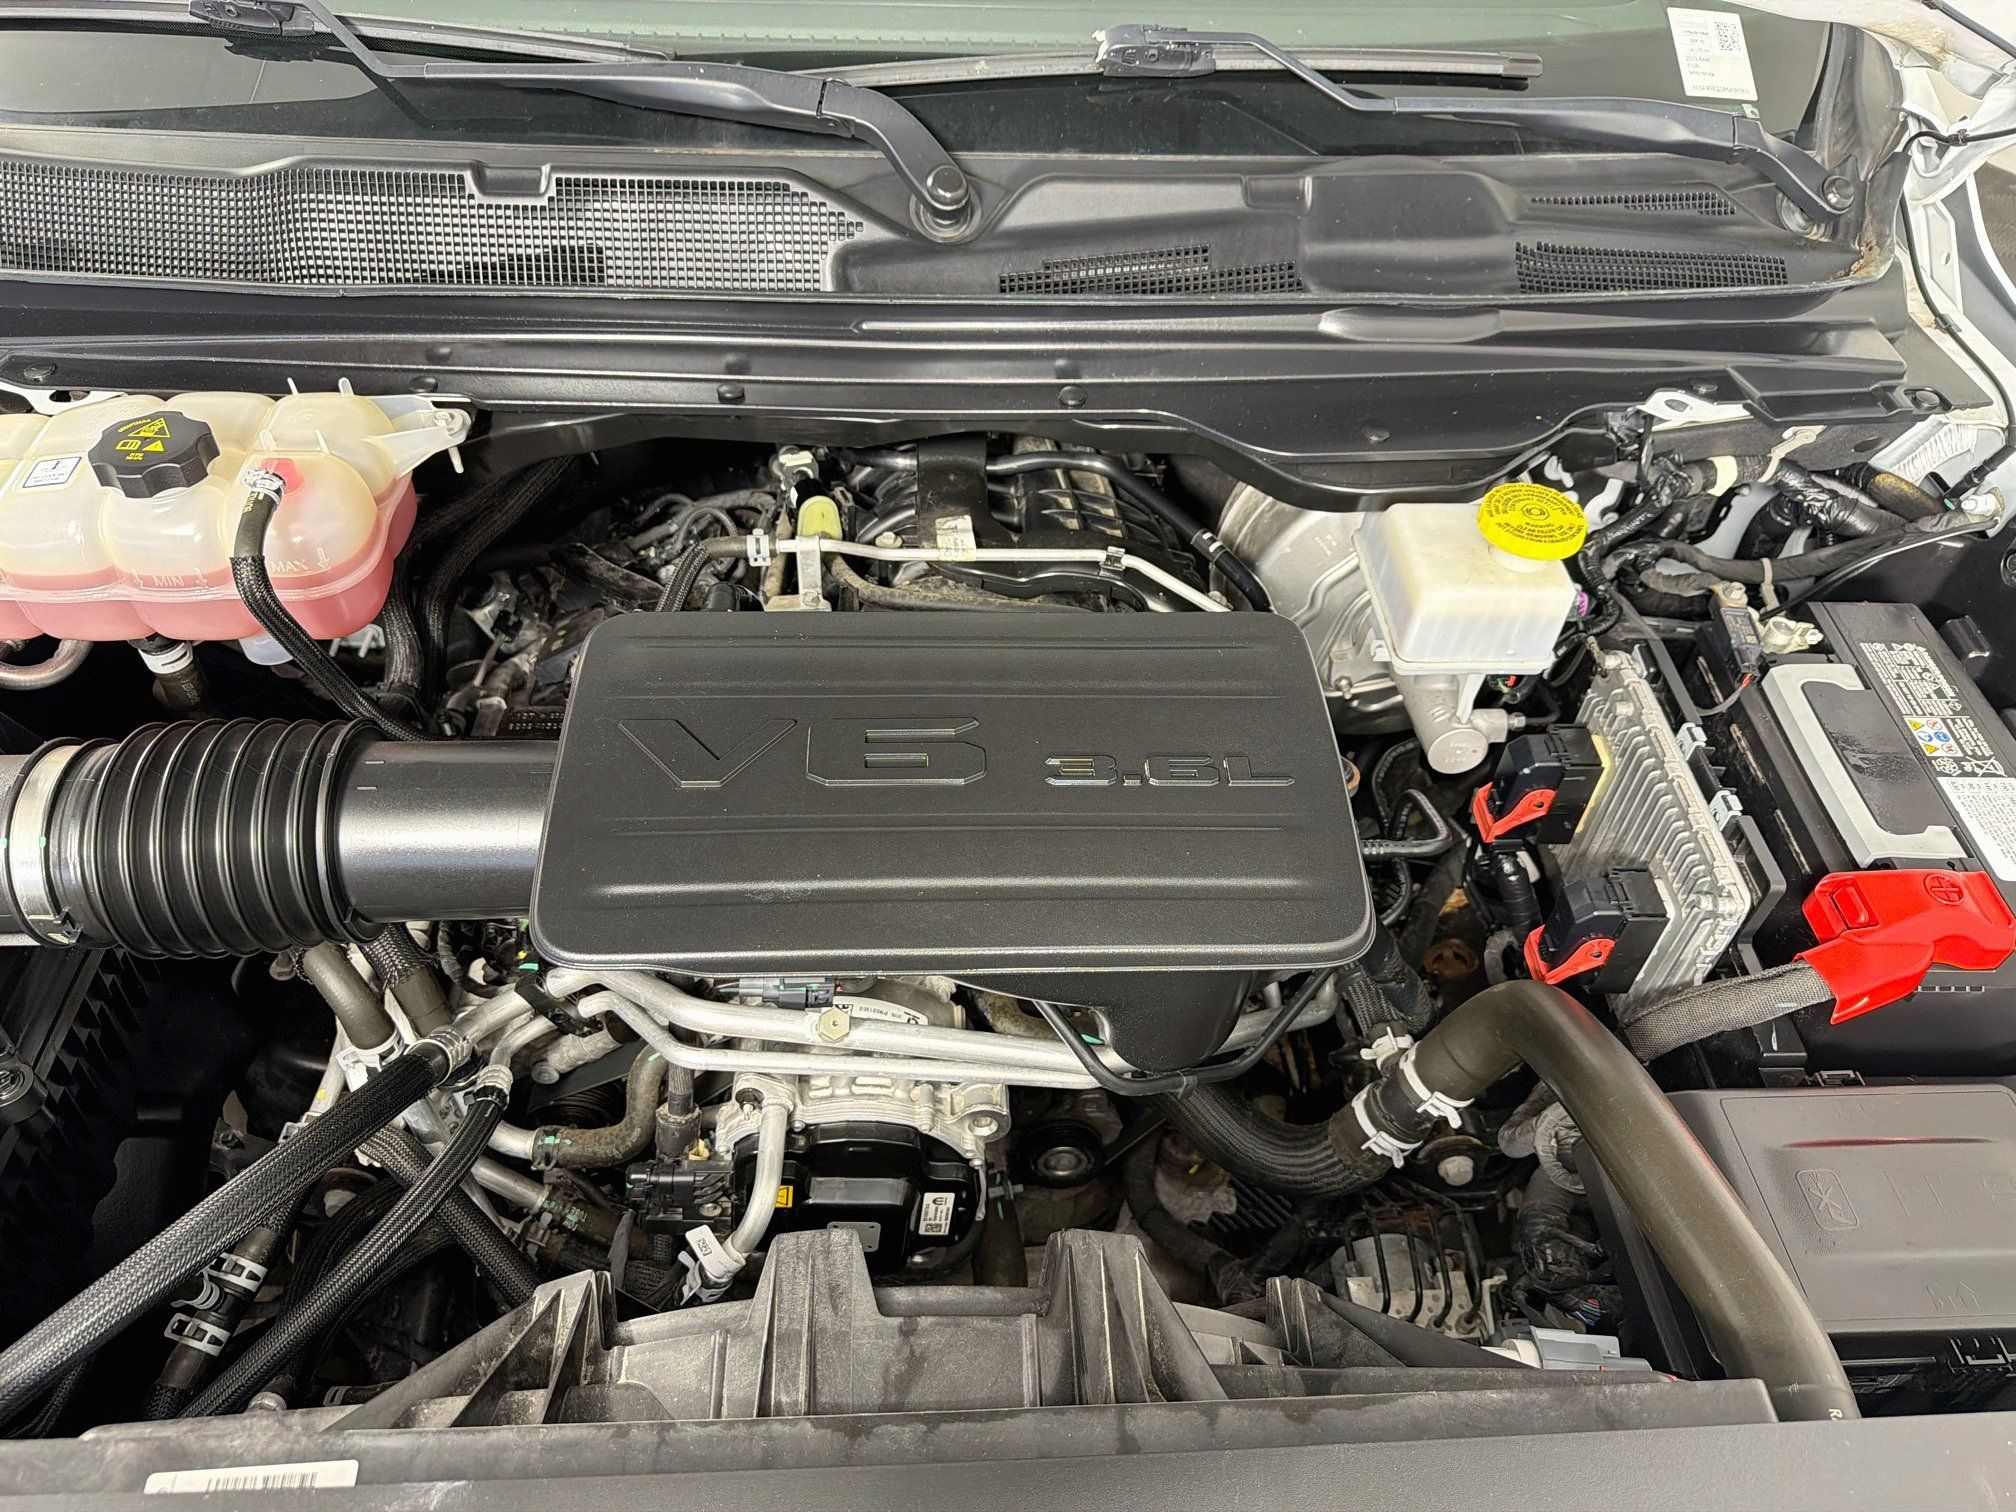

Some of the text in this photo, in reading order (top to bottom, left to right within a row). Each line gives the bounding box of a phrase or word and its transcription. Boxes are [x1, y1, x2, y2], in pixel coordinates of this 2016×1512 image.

[269, 559, 309, 571] MAX
[153, 575, 184, 586] MIN
[618, 717, 1295, 788] V6 3.6L
